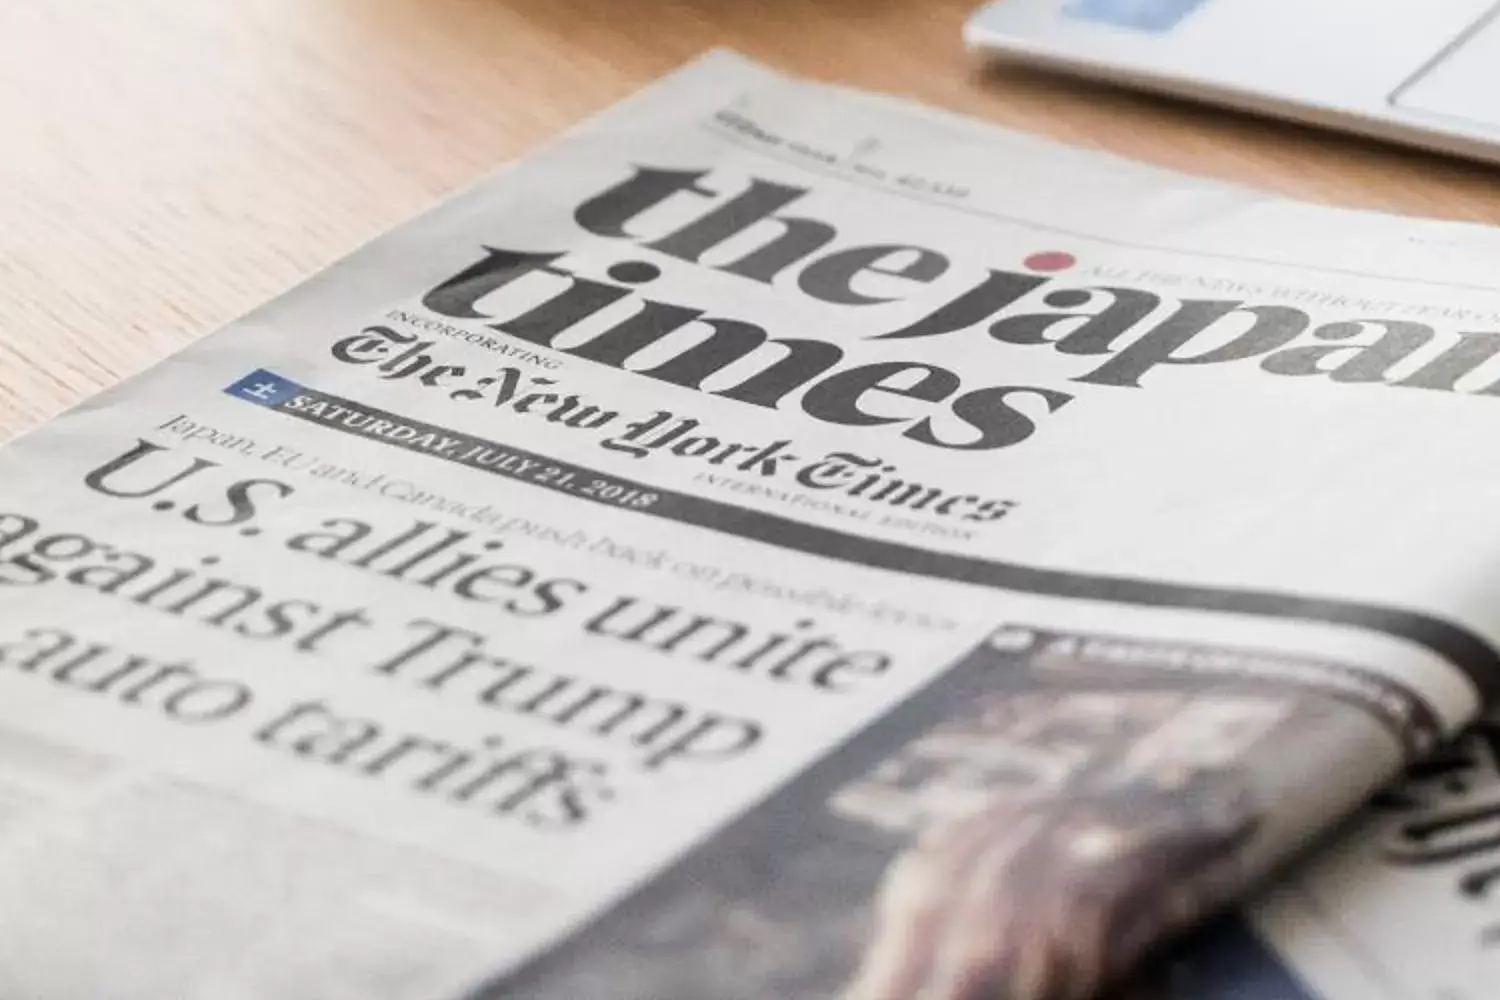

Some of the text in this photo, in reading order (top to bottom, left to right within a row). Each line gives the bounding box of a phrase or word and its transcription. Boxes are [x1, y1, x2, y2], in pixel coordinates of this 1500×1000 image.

[573, 163, 950, 305] the
[331, 325, 1020, 522] The New York Times
[386, 309, 564, 370] INCORPORATING
[421, 244, 1076, 451] times
[283, 394, 660, 508] SATURDAY, JULY 21, 2018
[83, 436, 891, 692] U.S. allies unite
[0, 625, 616, 832] auto tariffs
[374, 617, 764, 772] Trump
